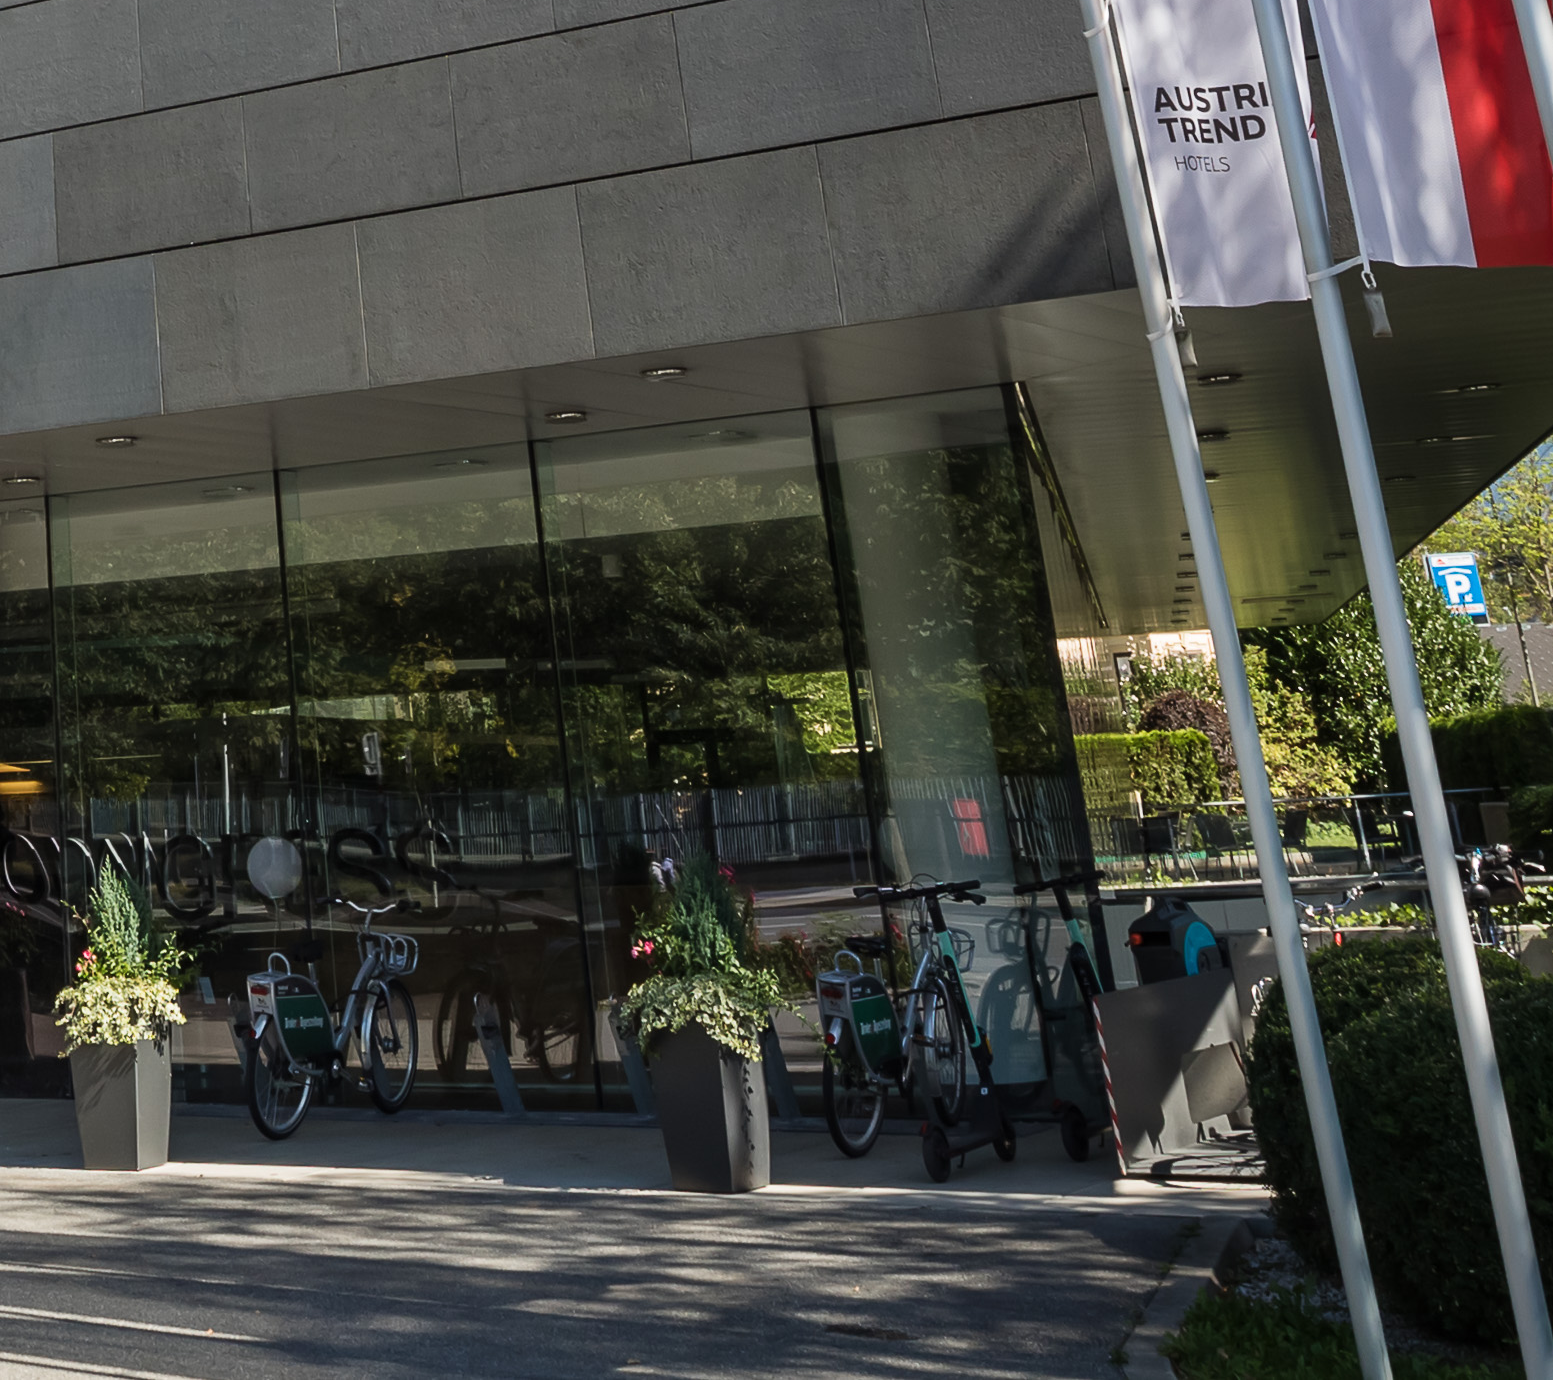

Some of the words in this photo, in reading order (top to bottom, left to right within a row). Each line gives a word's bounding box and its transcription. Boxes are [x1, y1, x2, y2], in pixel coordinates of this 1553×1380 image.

[1154, 81, 1272, 113] AUSTRI
[1158, 114, 1267, 144] TREND
[1174, 155, 1231, 173] HOTELS
[1444, 573, 1472, 604] P
